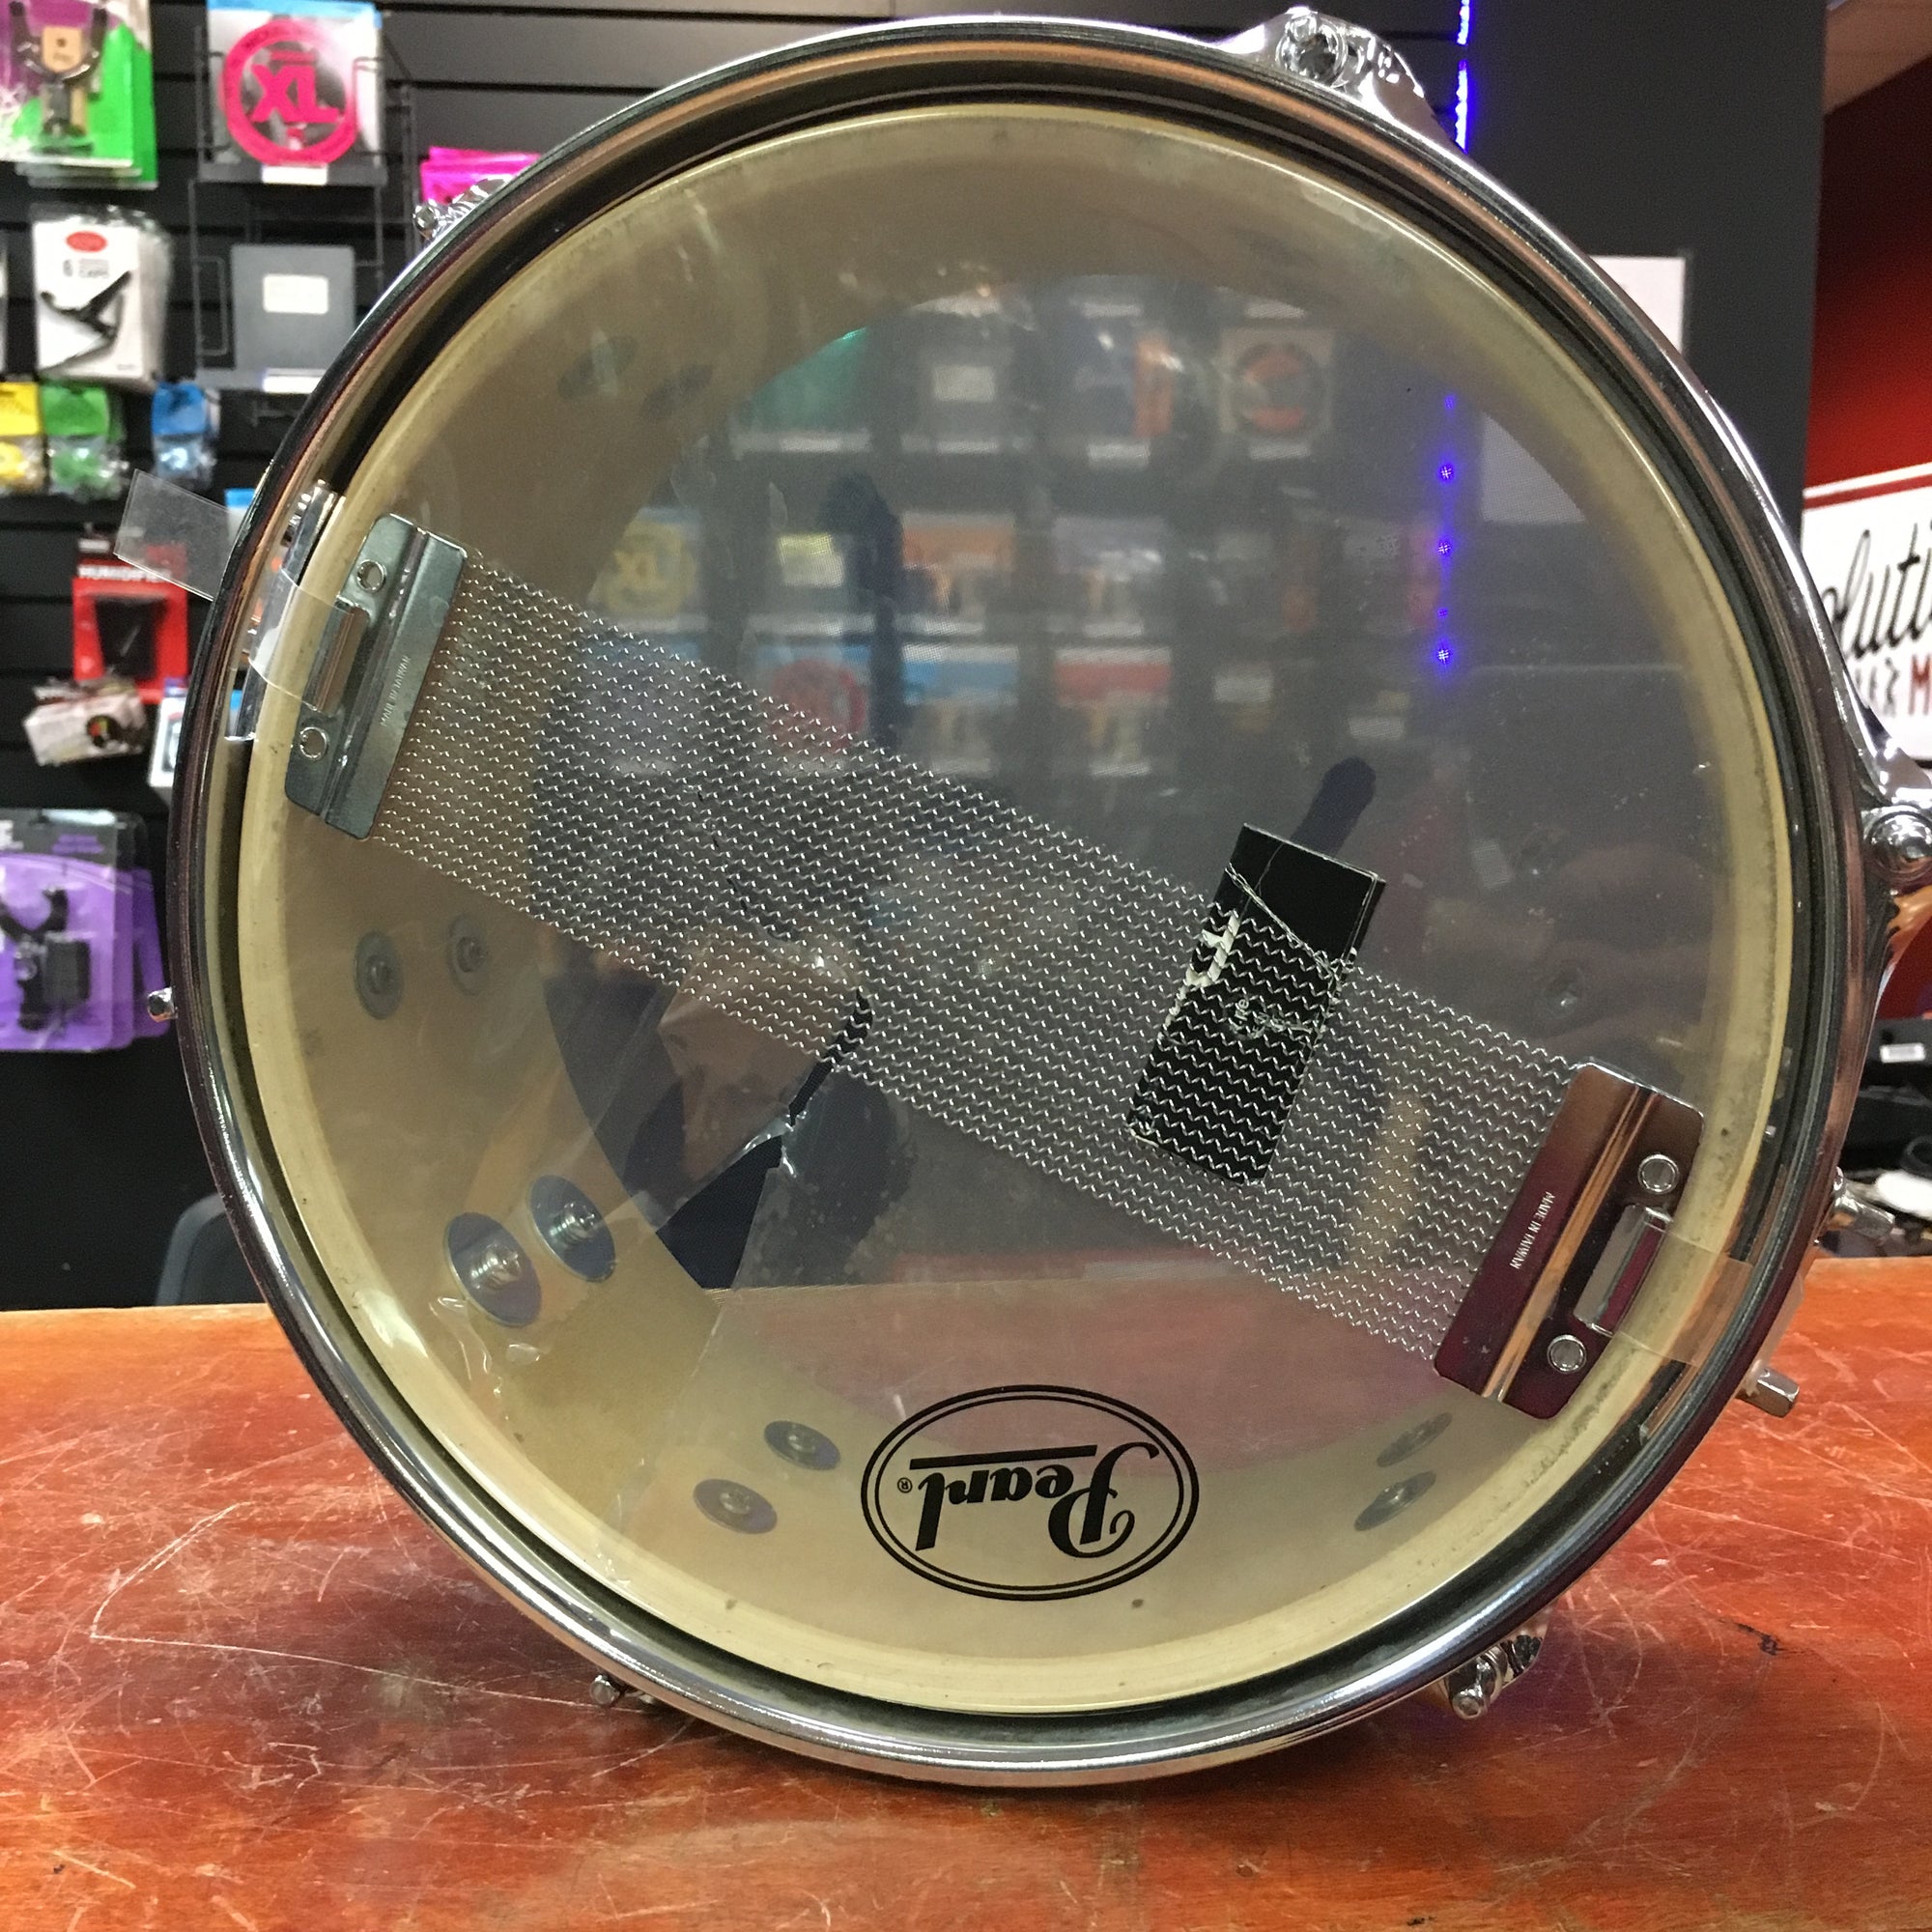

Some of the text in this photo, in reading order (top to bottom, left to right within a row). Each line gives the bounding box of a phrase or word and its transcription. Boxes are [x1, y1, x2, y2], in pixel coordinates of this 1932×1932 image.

[250, 64, 340, 123] XL
[1509, 1191, 1556, 1269] MADE IN TAIWAN
[916, 1441, 1160, 1558] Pearl
